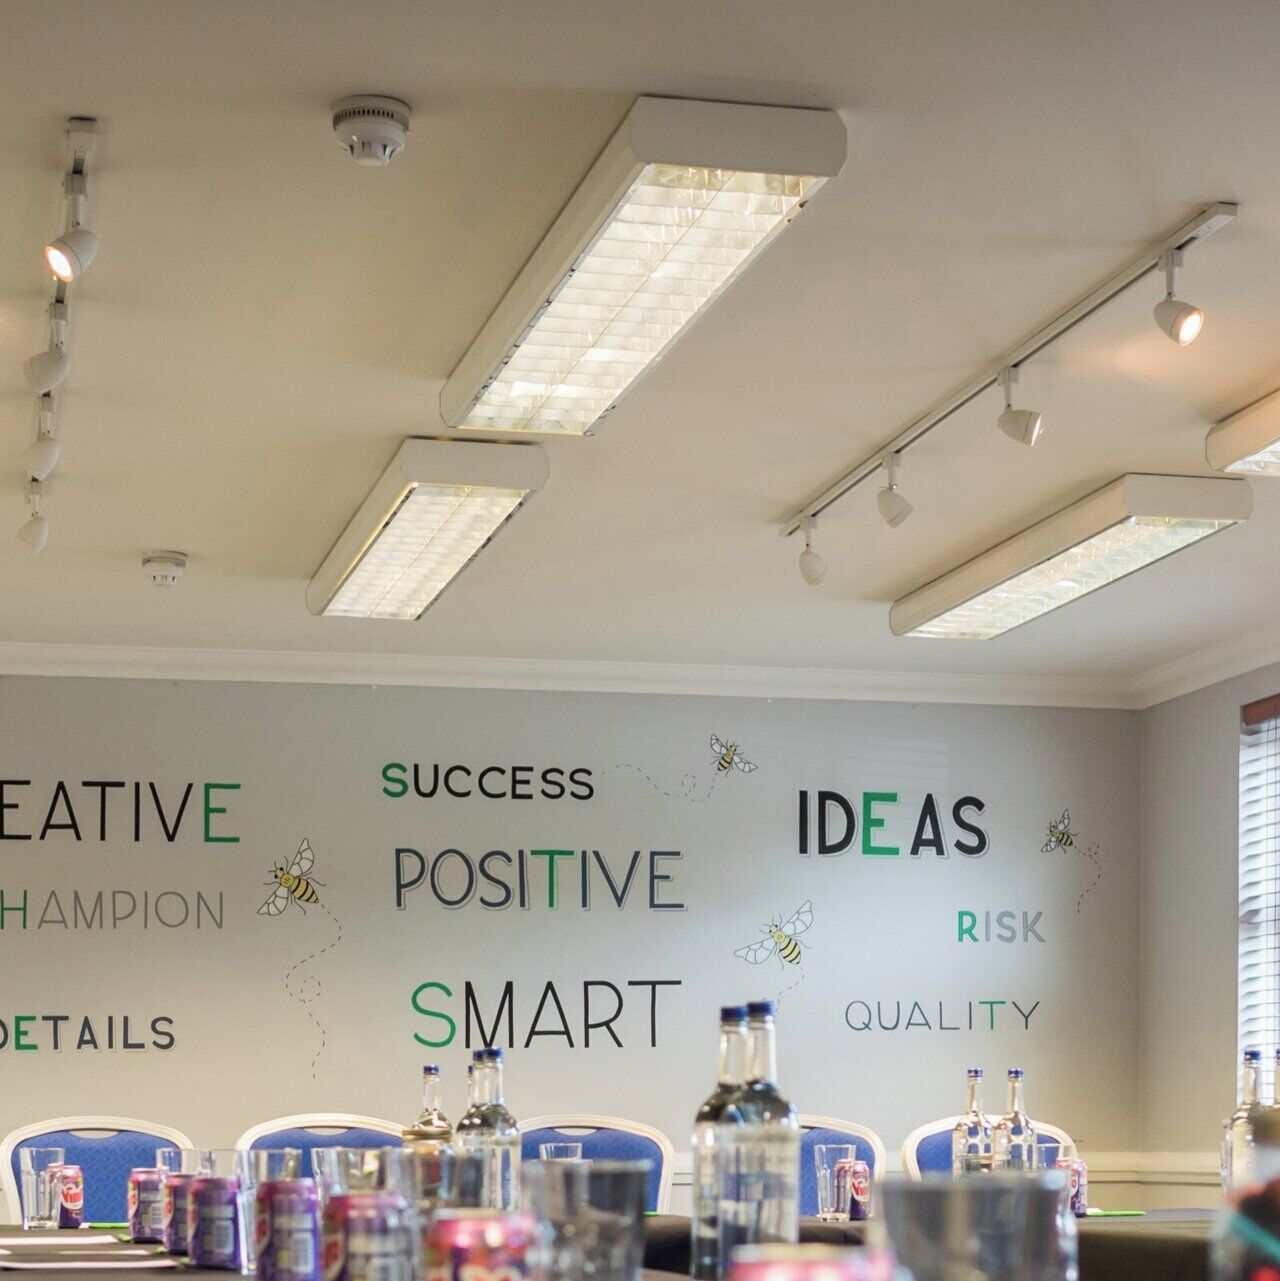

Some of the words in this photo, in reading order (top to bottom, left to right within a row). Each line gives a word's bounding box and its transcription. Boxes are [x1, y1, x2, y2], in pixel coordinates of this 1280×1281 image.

[381, 762, 595, 801] SUCCESS
[799, 790, 988, 857] IDEAS
[395, 848, 685, 910] POSITIVE
[958, 910, 1046, 943] RISK
[411, 980, 682, 1049] SMART
[845, 1000, 1040, 1032] QUALITY
